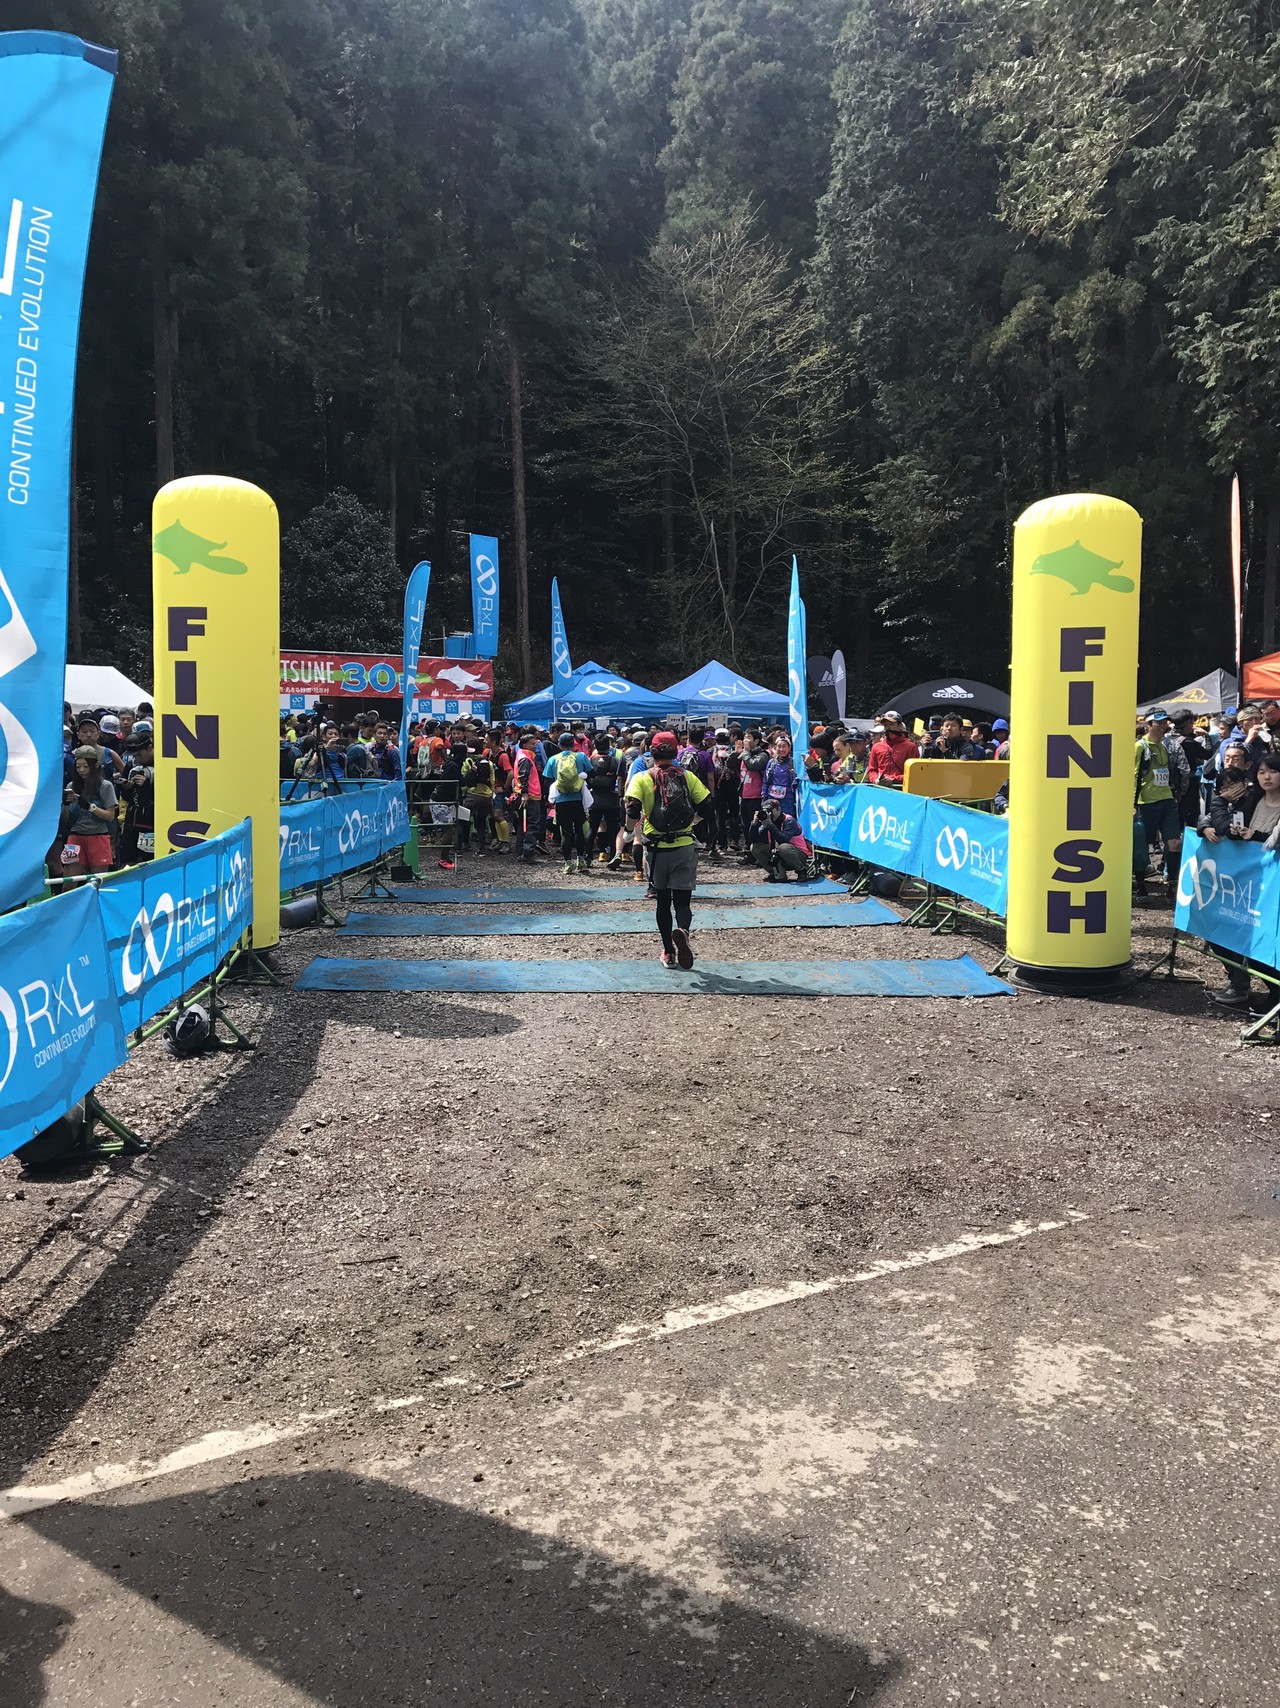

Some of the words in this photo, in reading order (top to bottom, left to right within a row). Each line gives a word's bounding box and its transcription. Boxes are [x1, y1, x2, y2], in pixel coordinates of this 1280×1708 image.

[19, 206, 53, 351] EVOLUTION
[8, 356, 37, 505] CONTINUED
[161, 606, 220, 855] FINIS
[280, 659, 335, 684] TSUNE
[932, 690, 974, 699] adidas
[1046, 626, 1112, 934] FINISH
